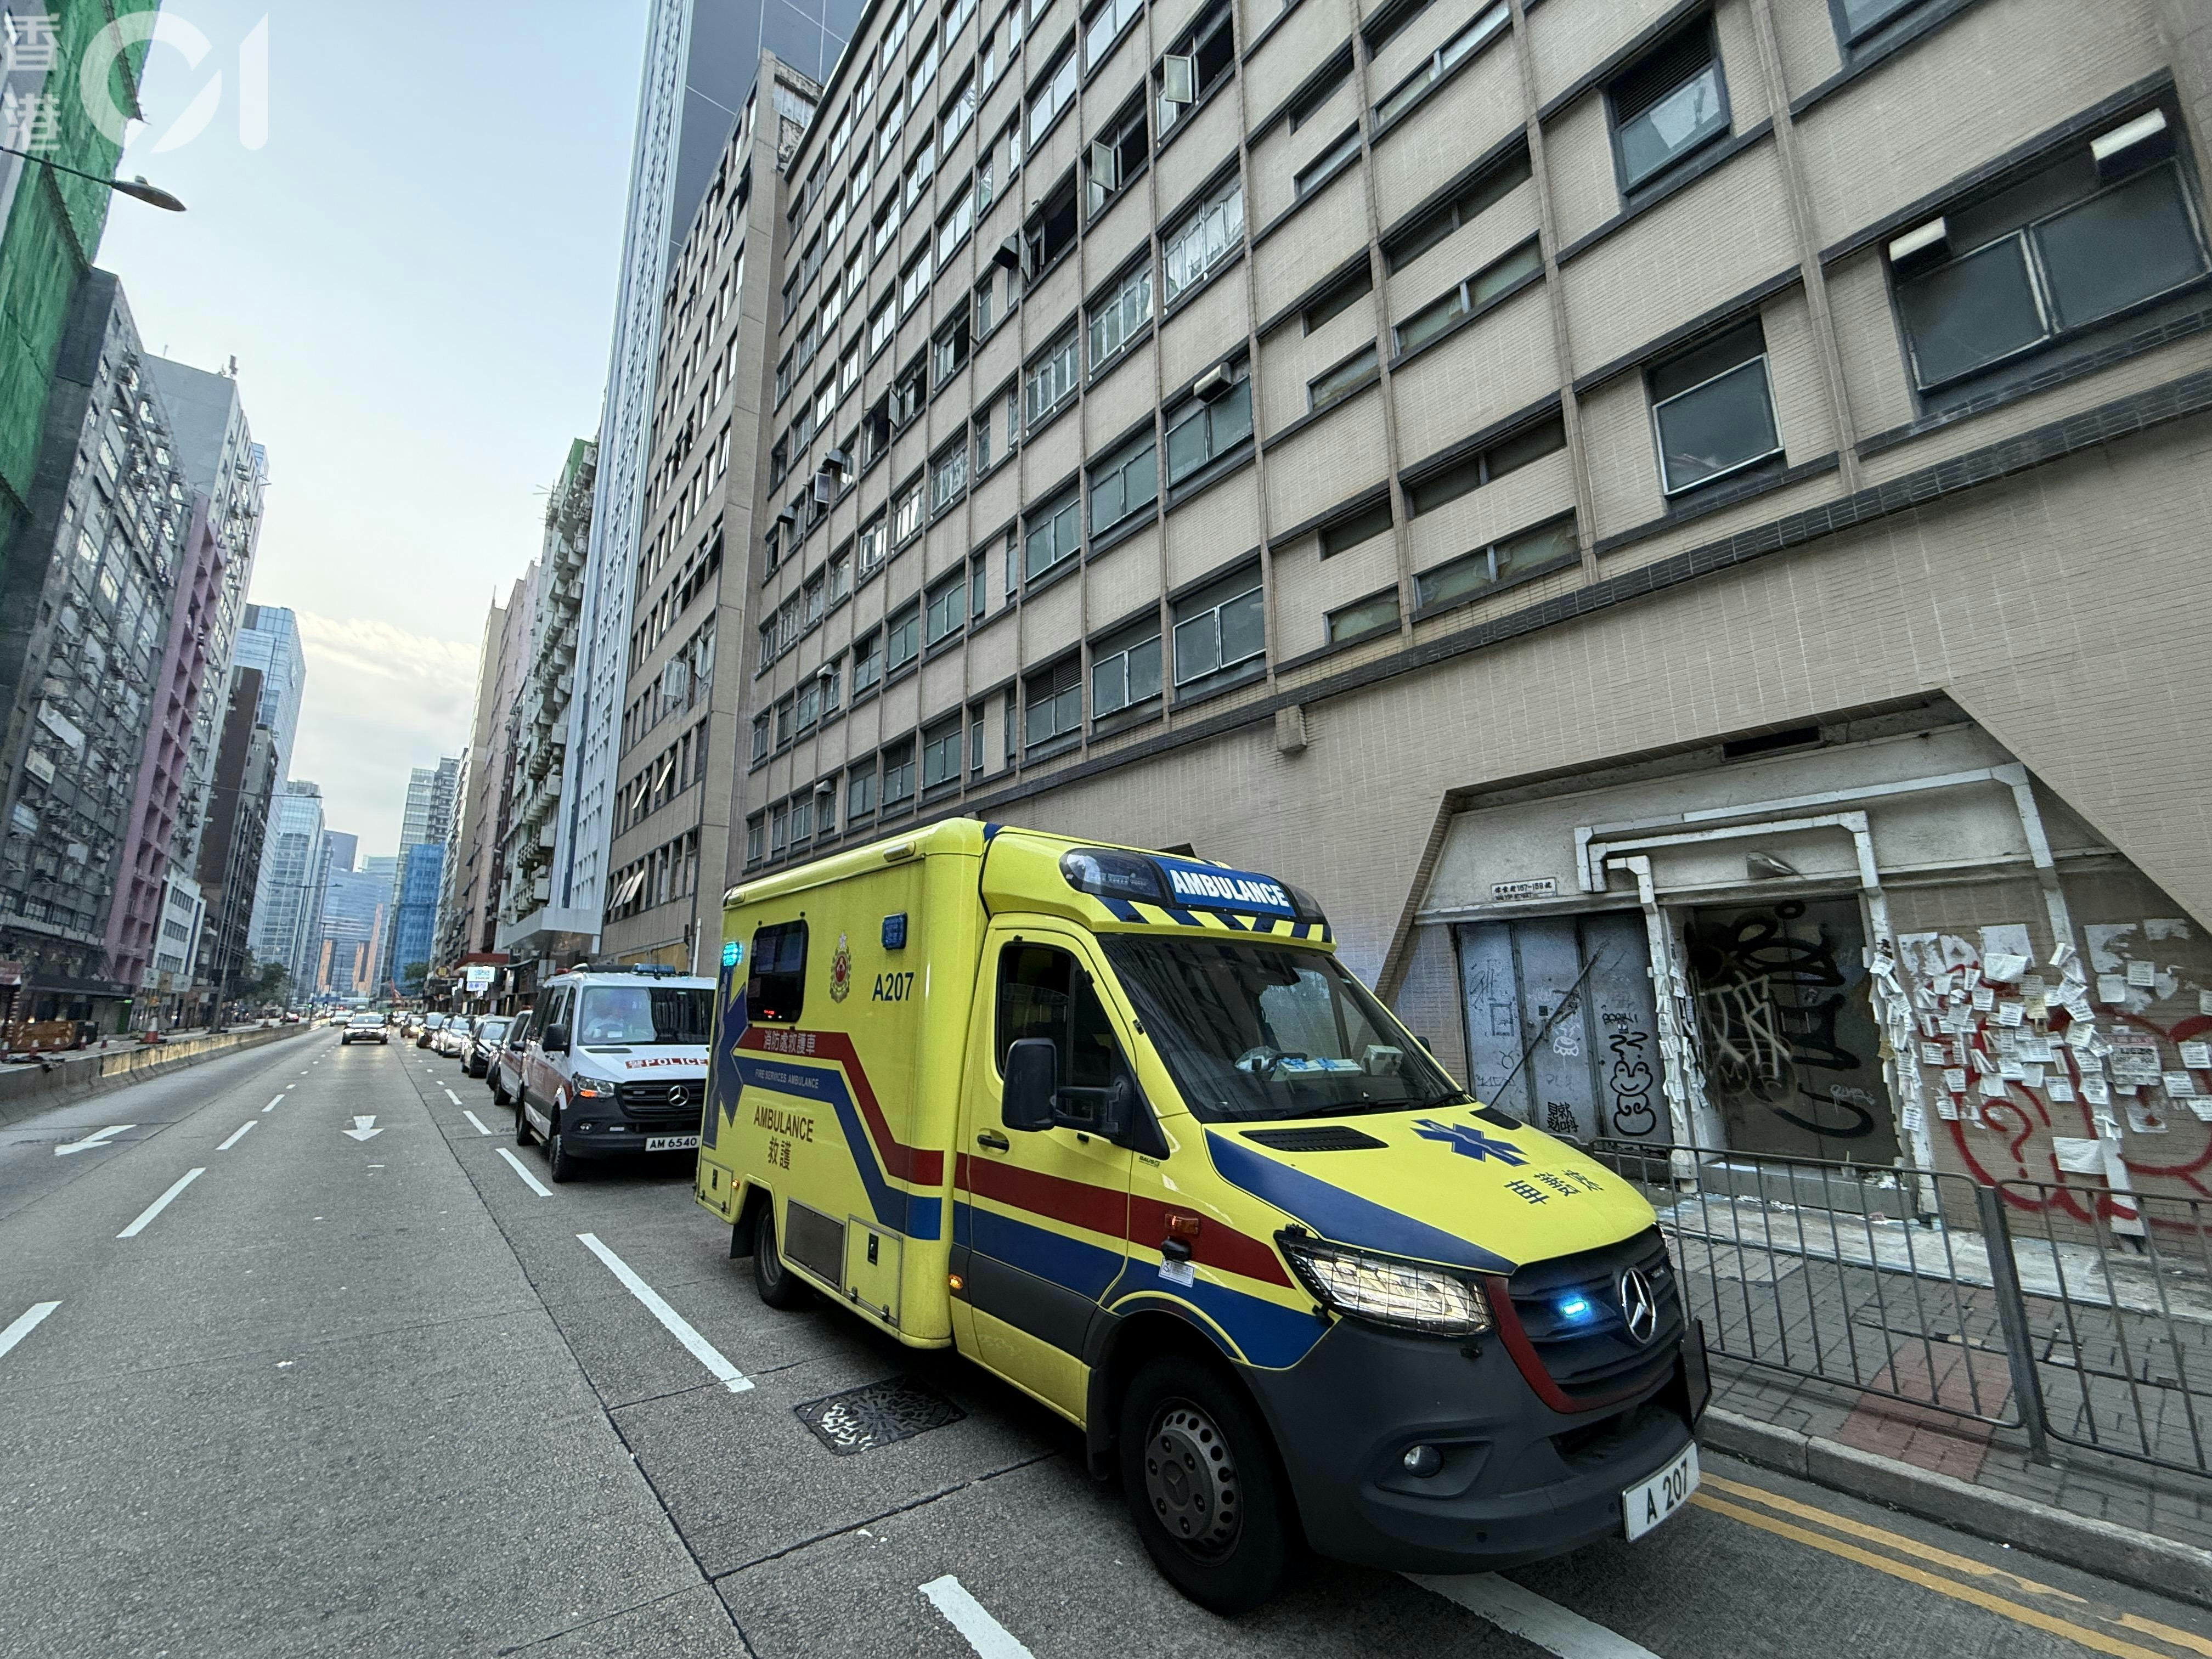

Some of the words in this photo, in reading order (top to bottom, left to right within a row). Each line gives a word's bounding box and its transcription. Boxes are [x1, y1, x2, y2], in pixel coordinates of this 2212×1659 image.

[1169, 870, 1290, 907] AMBULANCE
[872, 972, 915, 1002] A207
[763, 1030, 816, 1056] 消防處救護車
[645, 1058, 706, 1067] POLICE
[755, 1069, 765, 1079] FIRE
[765, 1071, 787, 1083] SERVICES
[787, 1074, 819, 1089] AMBULANCE
[753, 1105, 814, 1143] AMBULANCE
[650, 1139, 665, 1149] AM
[668, 1138, 697, 1148] 6540
[768, 1136, 791, 1171] 救護
[1647, 1487, 1658, 1525] A
[1662, 1457, 1688, 1511] 207
